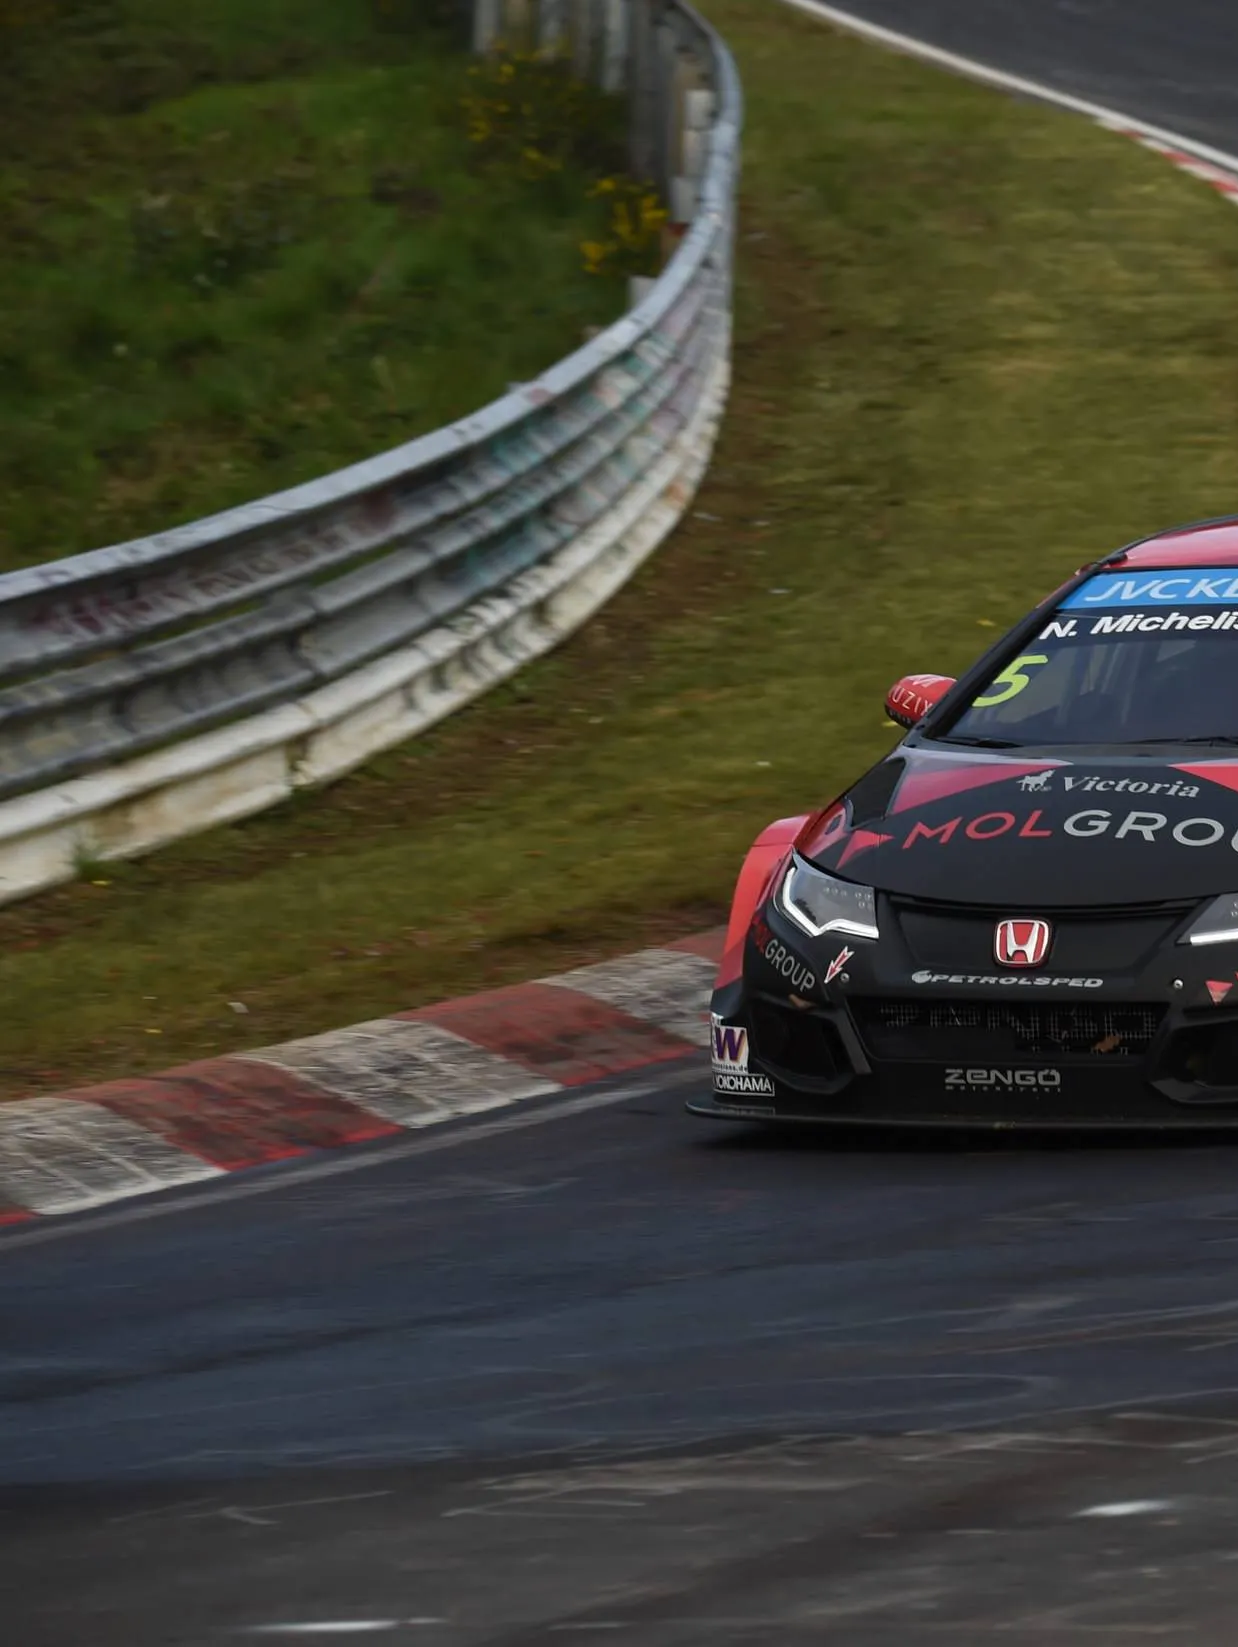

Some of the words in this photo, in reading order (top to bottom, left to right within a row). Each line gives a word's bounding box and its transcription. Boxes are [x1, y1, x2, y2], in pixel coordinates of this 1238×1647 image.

[1039, 620, 1077, 640] N.
[972, 654, 1048, 707] 5
[889, 686, 933, 716] UZIX
[1063, 776, 1200, 798] Victoria
[931, 974, 1103, 988] PETROLSPED
